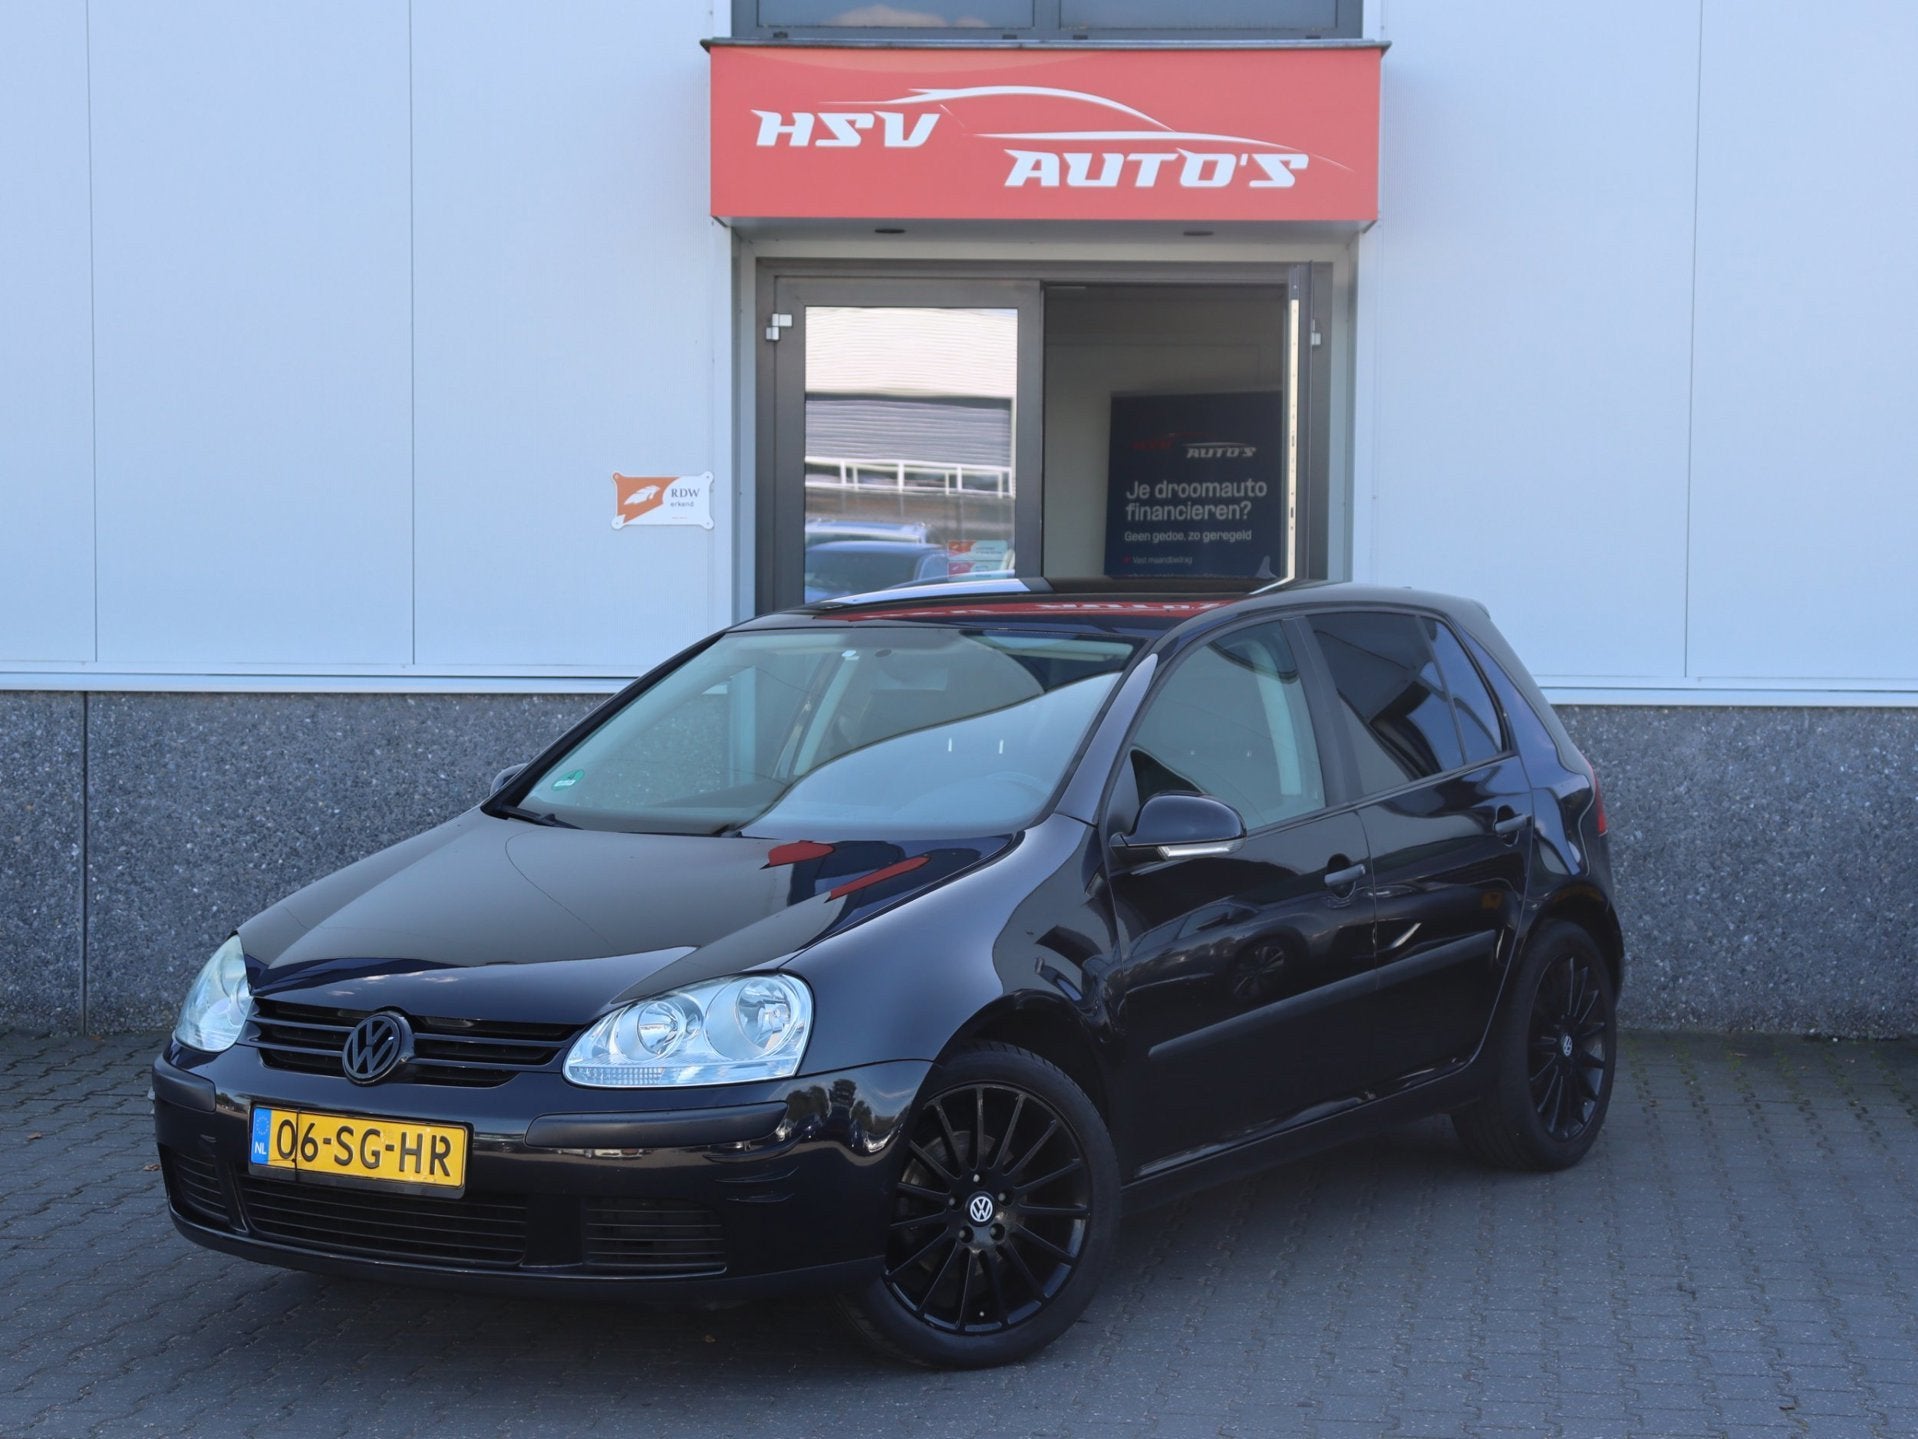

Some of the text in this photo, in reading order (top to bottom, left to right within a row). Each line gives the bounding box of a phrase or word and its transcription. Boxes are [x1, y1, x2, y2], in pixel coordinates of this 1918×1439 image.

[750, 110, 941, 148] HSV
[1003, 147, 1309, 189] AUTO'S
[1186, 446, 1257, 459] AUTO'S
[671, 488, 700, 498] RDW
[1126, 478, 1268, 499] Je droomauto
[1125, 500, 1252, 521] financieren?
[1124, 531, 1151, 542] Geen
[1188, 532, 1200, 541] zo
[1202, 530, 1252, 543] geregeld
[254, 1142, 267, 1155] NL
[276, 1119, 452, 1177] 06-SG-HR
